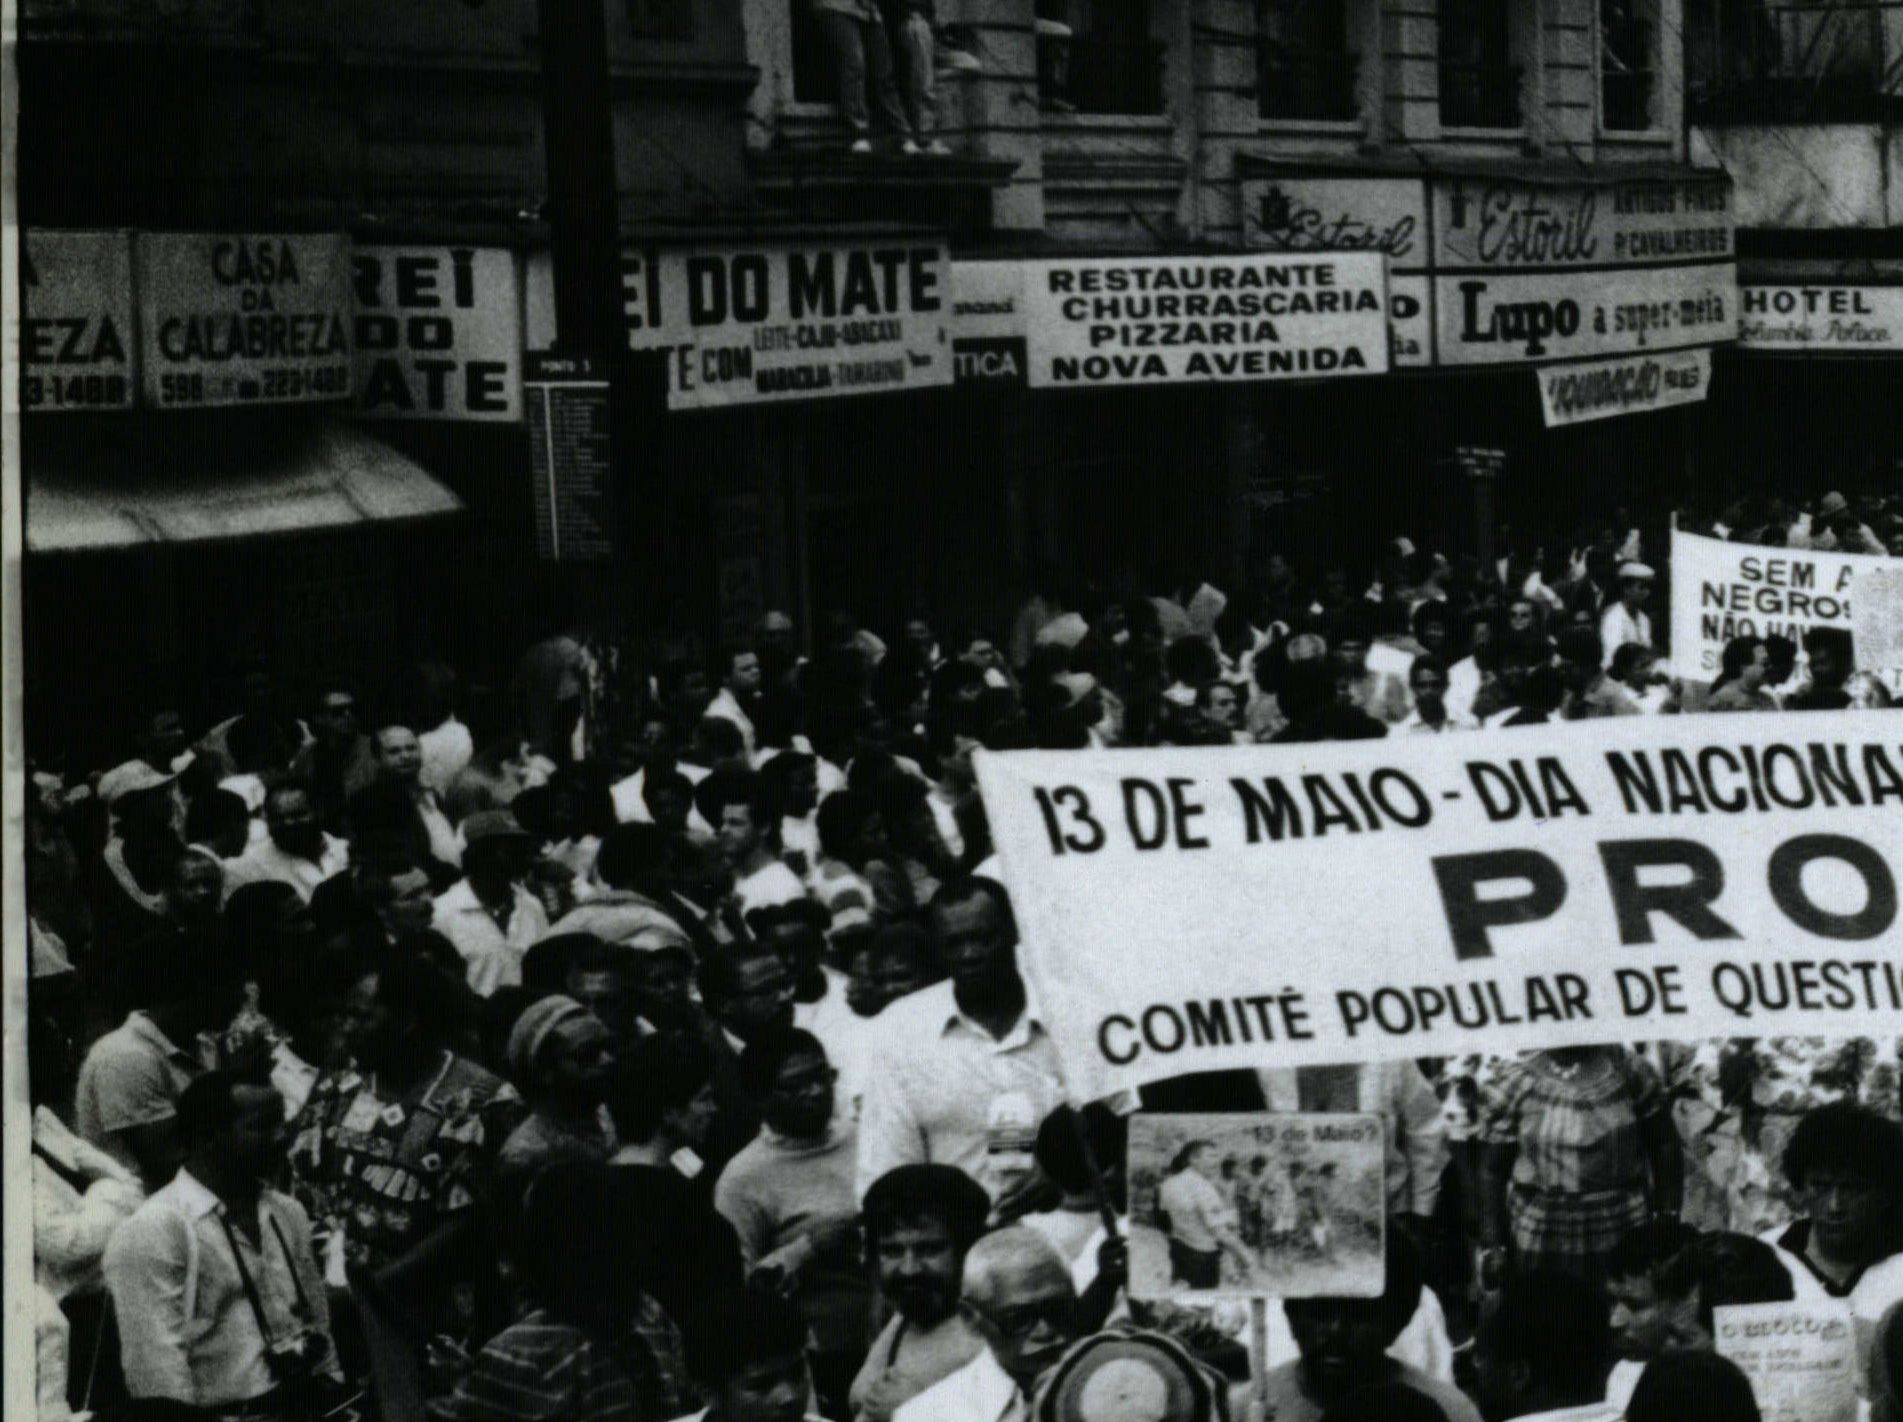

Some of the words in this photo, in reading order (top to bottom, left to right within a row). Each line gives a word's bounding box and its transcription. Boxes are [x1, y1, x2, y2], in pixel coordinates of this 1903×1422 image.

[1478, 185, 1598, 264] Estoril
[212, 242, 298, 285] CASA
[1049, 263, 1335, 295] RESTAURANTE
[241, 288, 273, 312] DA
[688, 254, 767, 325] DO
[789, 249, 939, 318] MATE
[1062, 289, 1379, 321] CHURRASCARIA
[1743, 288, 1873, 315] HOTEL
[355, 316, 453, 351] DO
[1089, 320, 1280, 349] PIZZARIA
[1459, 280, 1580, 356] Lupo
[1593, 303, 1608, 336] a
[1613, 289, 1726, 346] super-meia
[158, 315, 348, 361] CALABREZA
[1052, 354, 1168, 381] NOVA
[1185, 346, 1367, 377] AVENIDA
[355, 359, 508, 413] ATE
[1739, 555, 1817, 591] SEM
[1034, 783, 1106, 859] 13
[1124, 774, 1211, 853] DE
[1339, 970, 1595, 1039] POPULAR
[1615, 965, 1688, 1019] DE
